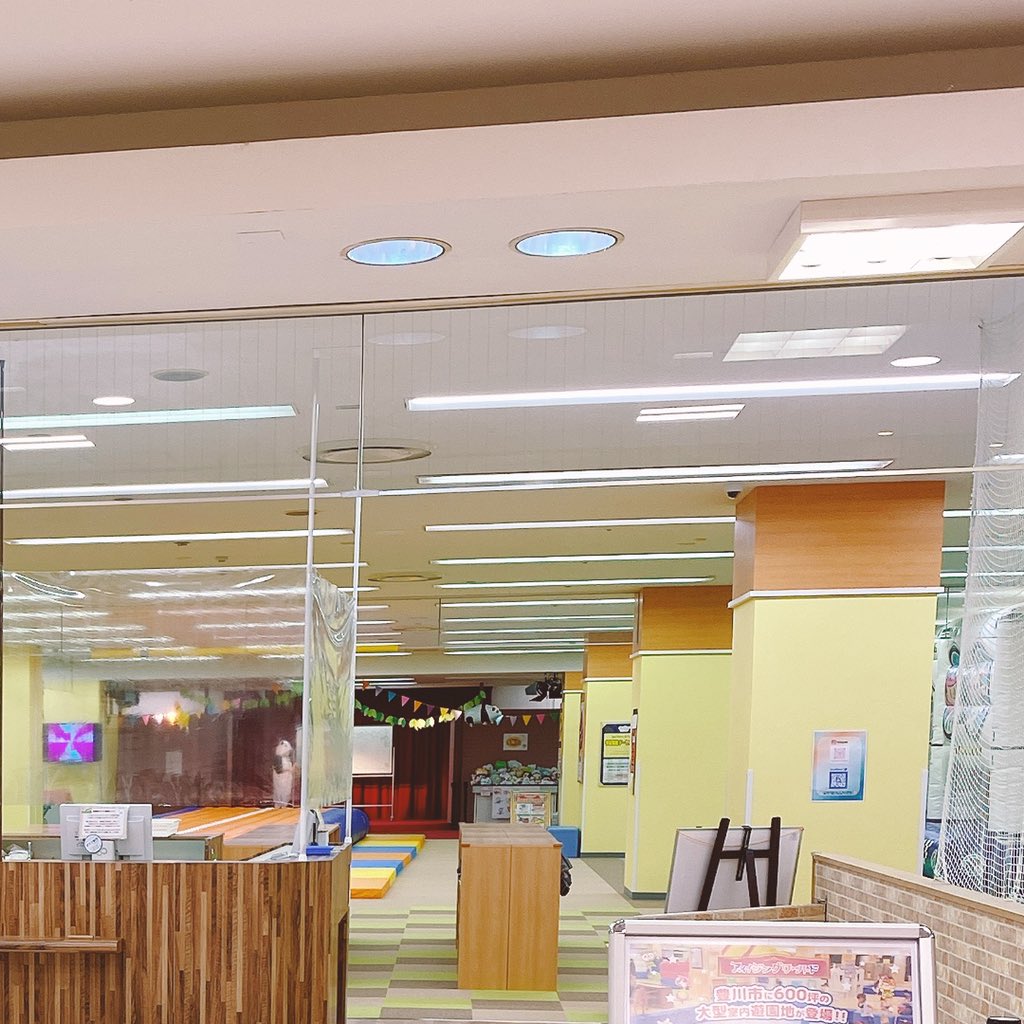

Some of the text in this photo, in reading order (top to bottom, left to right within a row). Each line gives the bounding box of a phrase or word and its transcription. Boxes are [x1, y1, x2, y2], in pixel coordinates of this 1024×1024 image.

[715, 986, 831, 1004] 豊川市に600坪の
